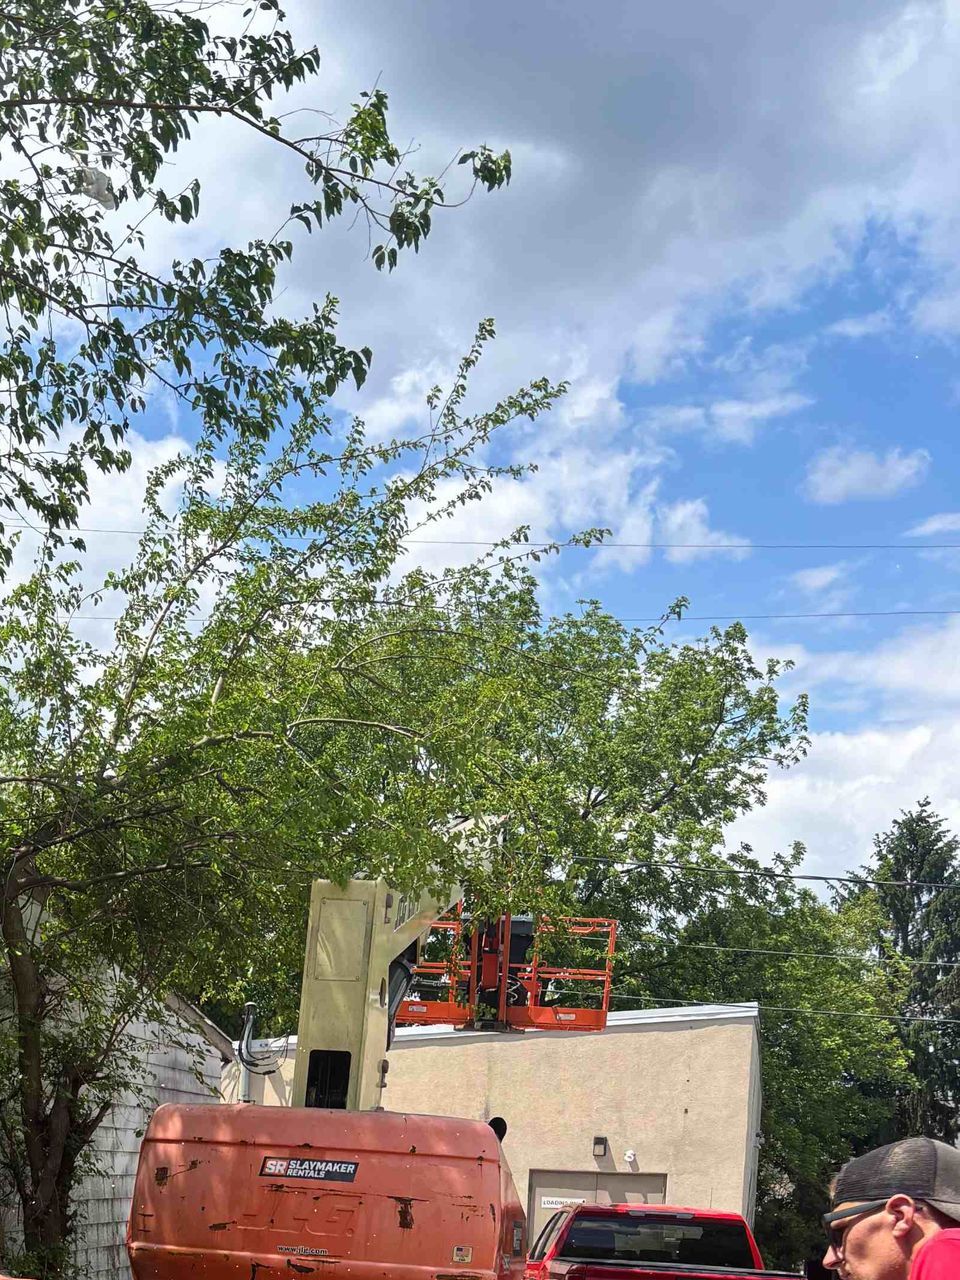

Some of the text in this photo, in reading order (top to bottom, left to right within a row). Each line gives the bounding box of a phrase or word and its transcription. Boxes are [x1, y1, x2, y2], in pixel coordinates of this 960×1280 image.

[265, 1160, 287, 1174] SR
[286, 1168, 326, 1178] RENTALS
[288, 1160, 355, 1174] SLAYMAKER
